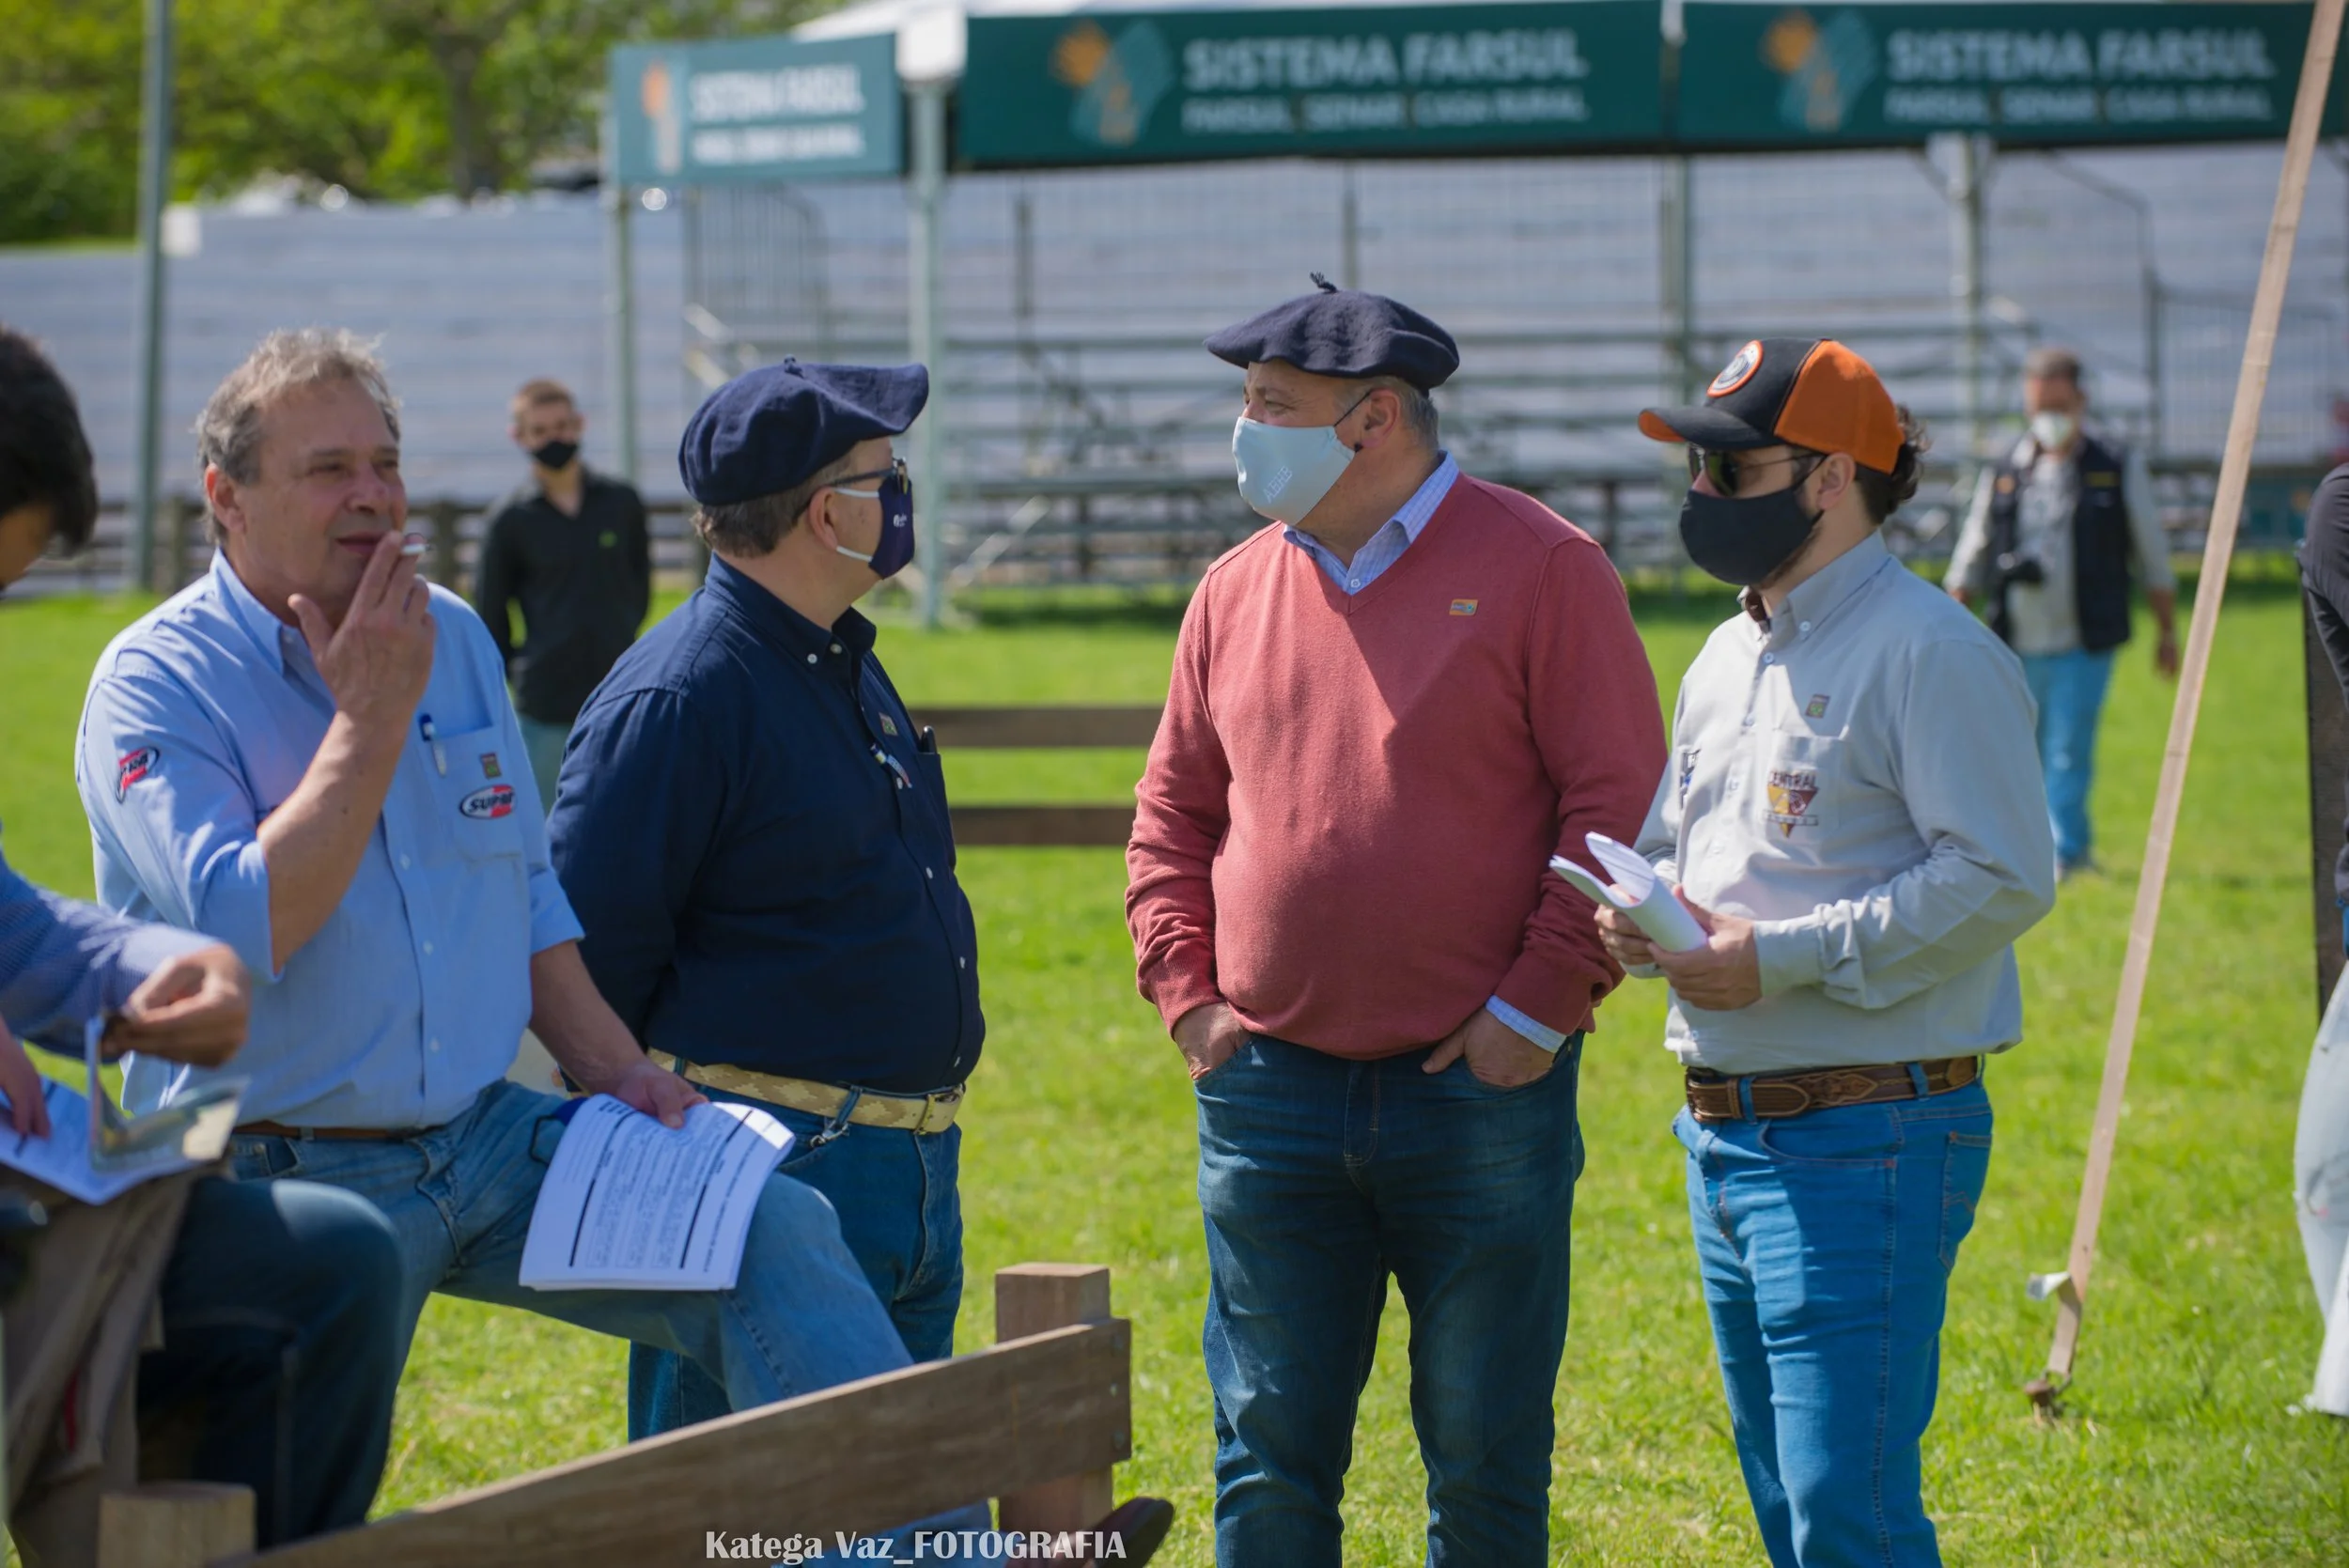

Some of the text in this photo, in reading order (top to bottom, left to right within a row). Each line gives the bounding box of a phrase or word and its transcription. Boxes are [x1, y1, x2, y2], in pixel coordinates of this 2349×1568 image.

[1183, 28, 1590, 90] SISTEMA FARSUL
[1887, 26, 2279, 81] SISTEMA FARSUL
